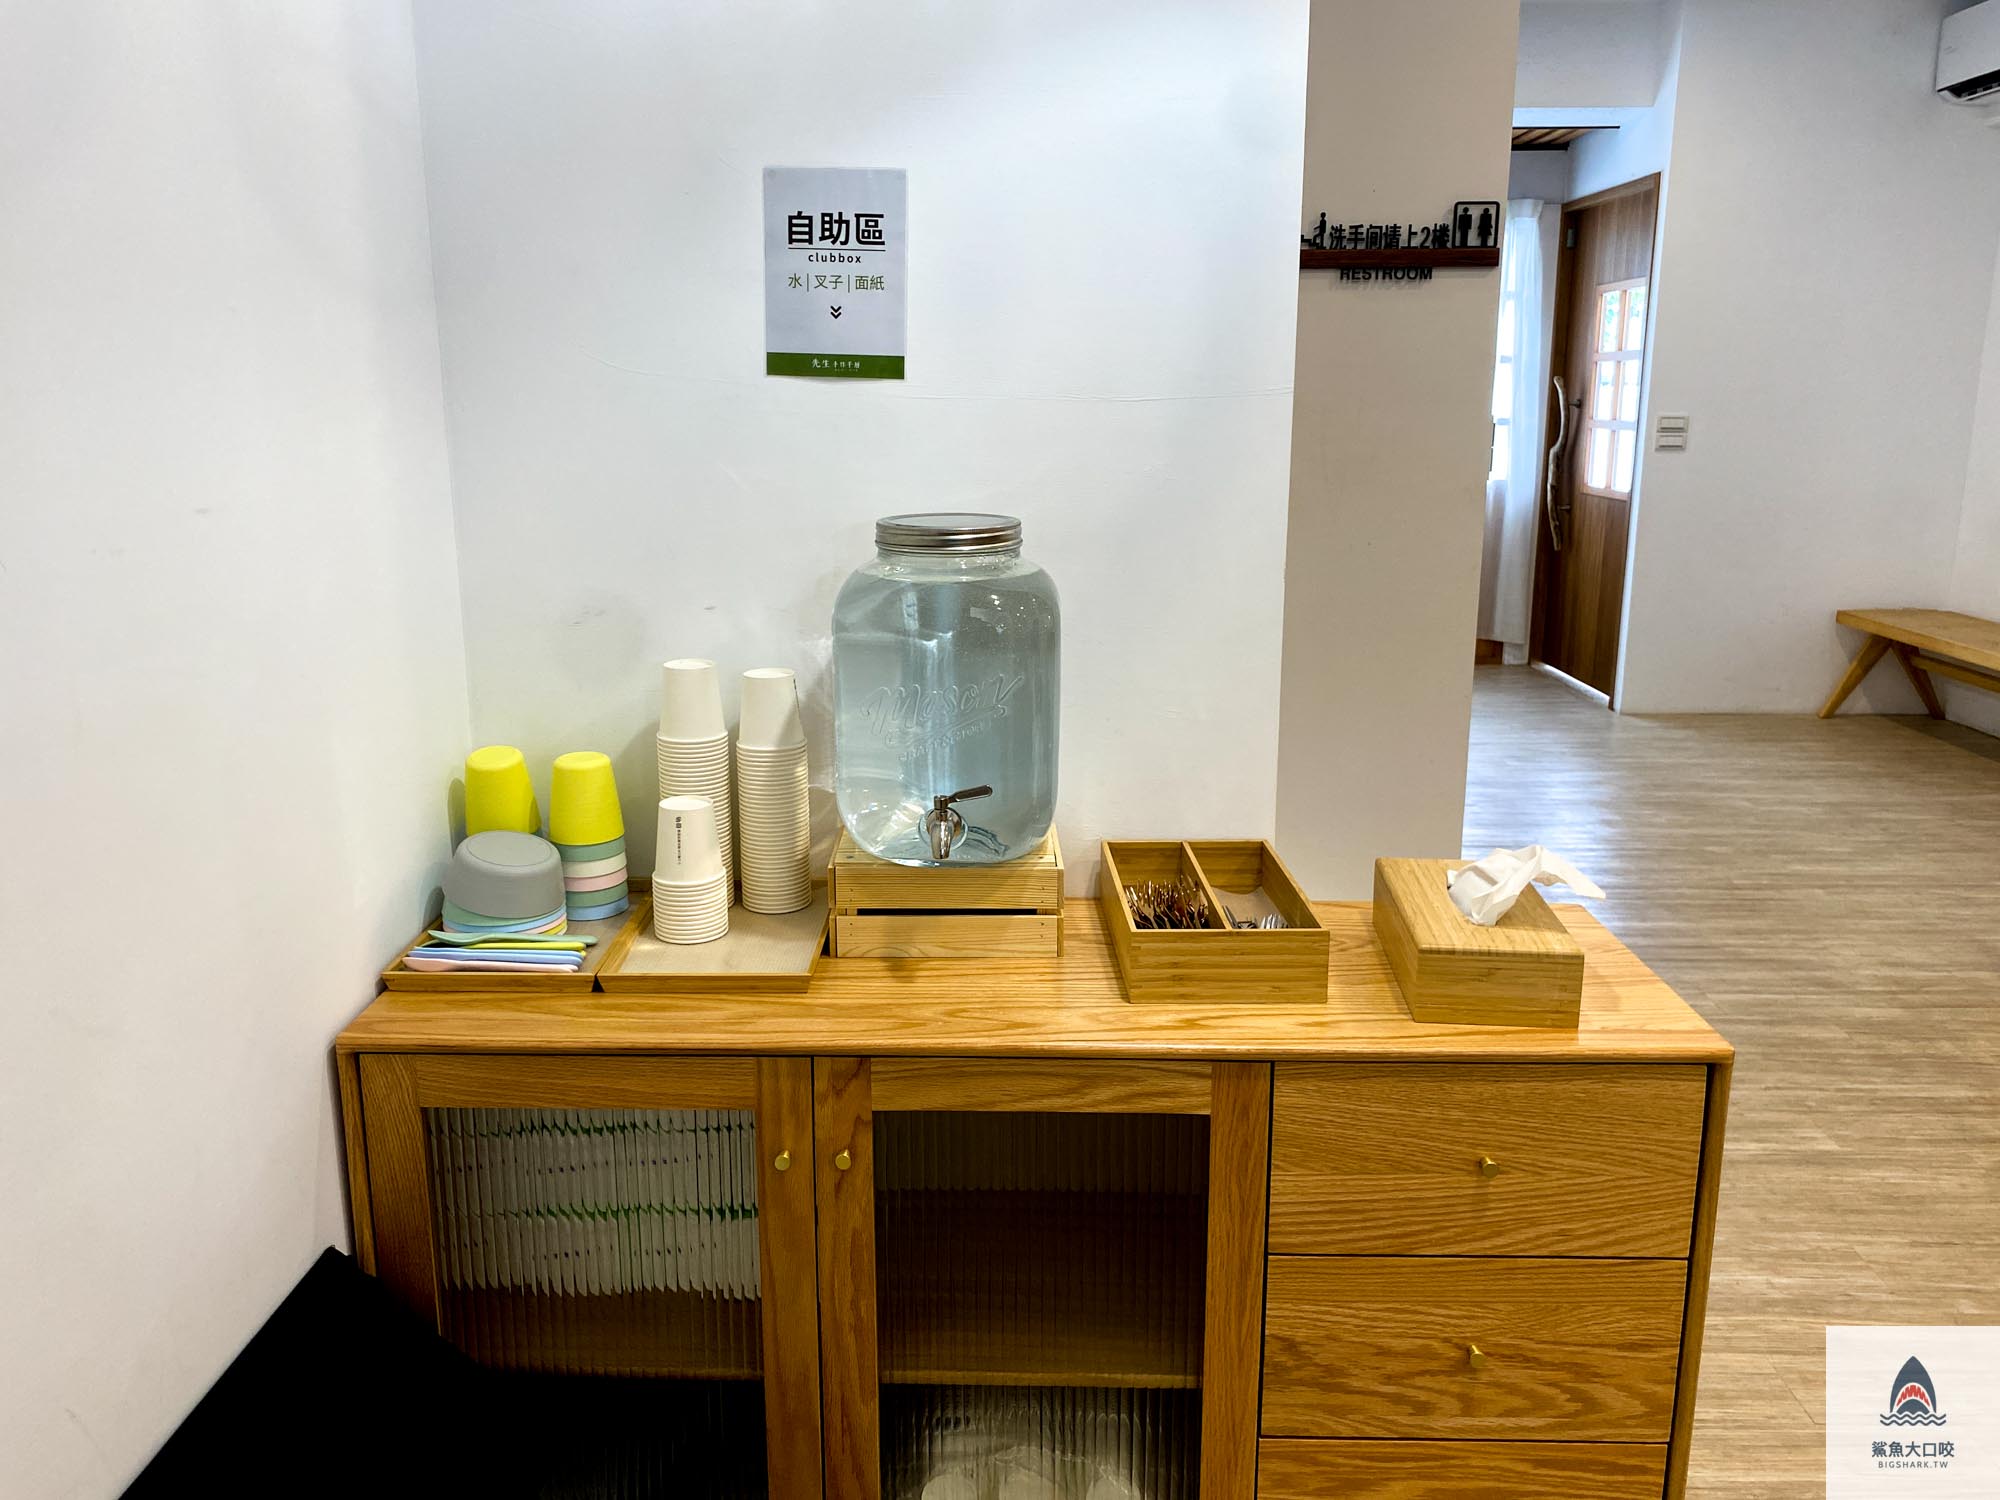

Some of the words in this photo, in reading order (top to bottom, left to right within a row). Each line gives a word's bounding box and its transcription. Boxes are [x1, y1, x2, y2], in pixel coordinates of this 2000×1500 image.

[787, 210, 886, 246] 自助區
[808, 252, 862, 264] clubbox
[1339, 267, 1433, 281] RESTROOM
